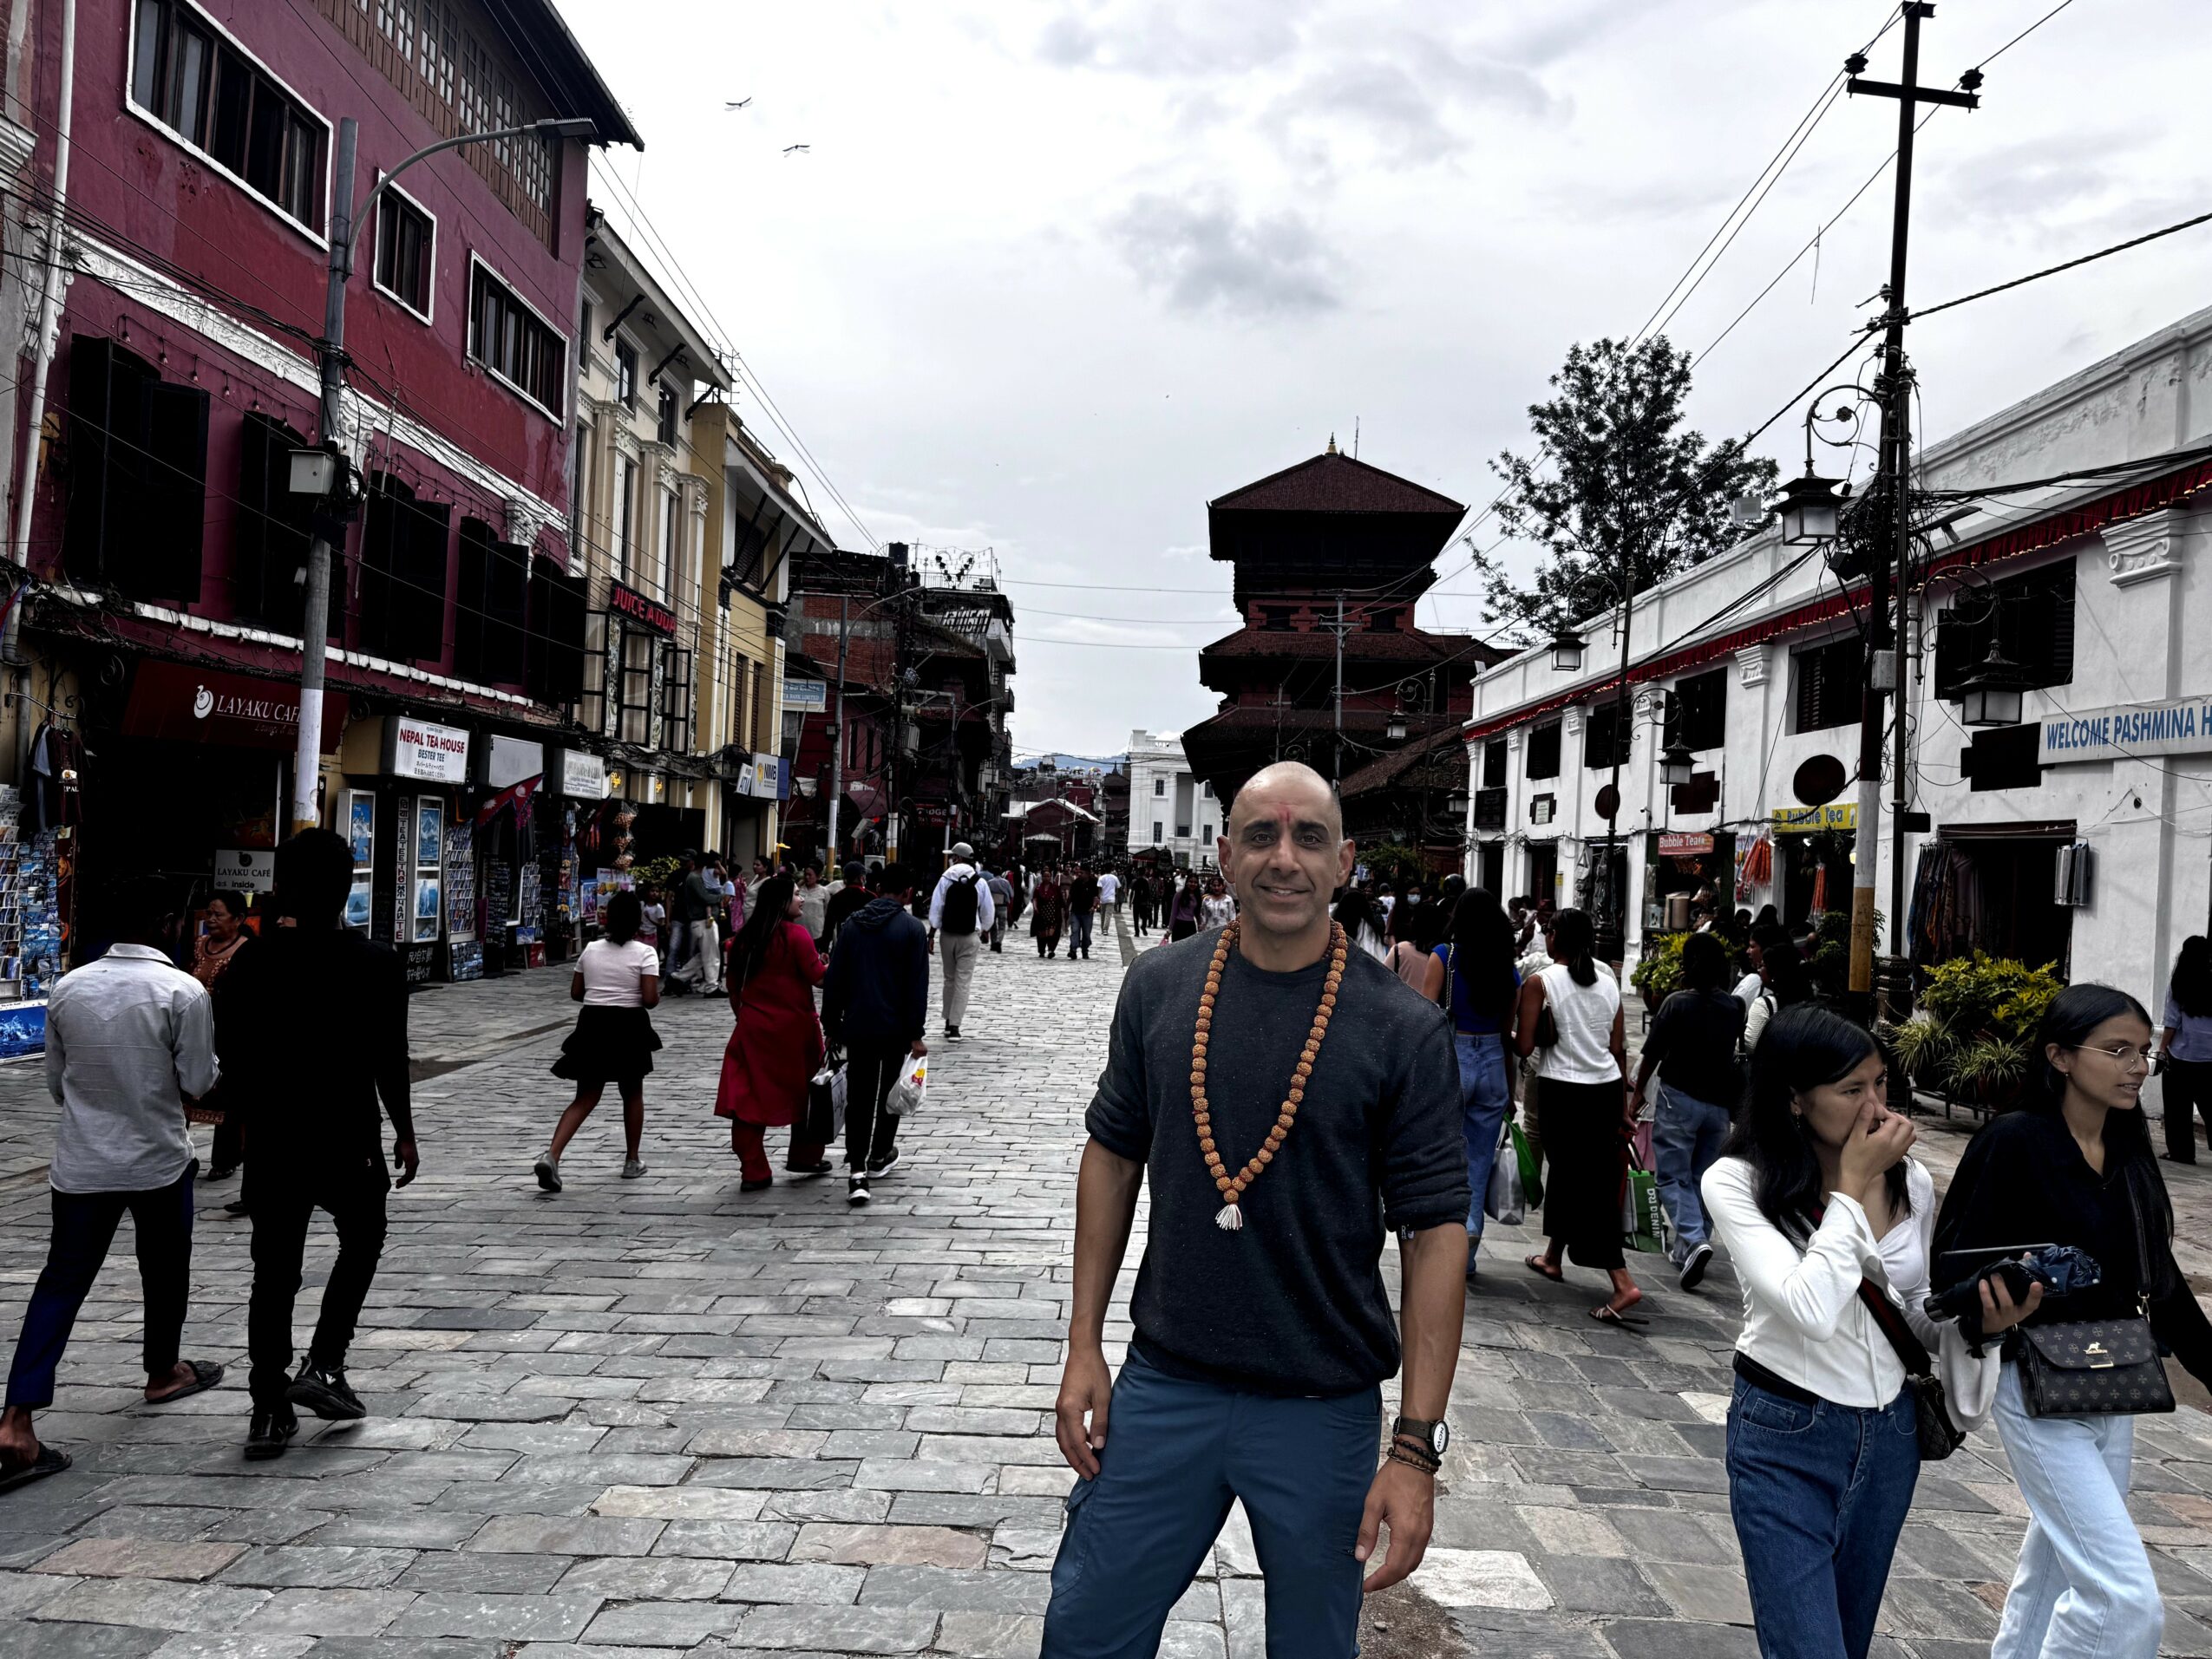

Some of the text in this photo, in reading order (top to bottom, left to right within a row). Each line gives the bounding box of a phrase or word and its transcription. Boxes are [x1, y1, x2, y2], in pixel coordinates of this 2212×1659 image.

[612, 586, 676, 633] JUICE ADDA
[216, 695, 274, 718] LAYAKU
[2046, 716, 2111, 750] WELCOME
[2113, 707, 2196, 744] PASHMINA
[399, 728, 424, 746] NEPAL
[426, 734, 439, 749] TEA
[440, 737, 465, 754] HOUSE
[417, 748, 445, 762] BESTER TEE
[738, 775, 750, 793] ATM
[1825, 806, 1843, 823] Tea
[398, 841, 407, 861] TEE
[1659, 836, 1683, 848] Bubble
[217, 868, 272, 878] LAYAKU CAFÉ
[1650, 1205, 1660, 1238] DENIM
